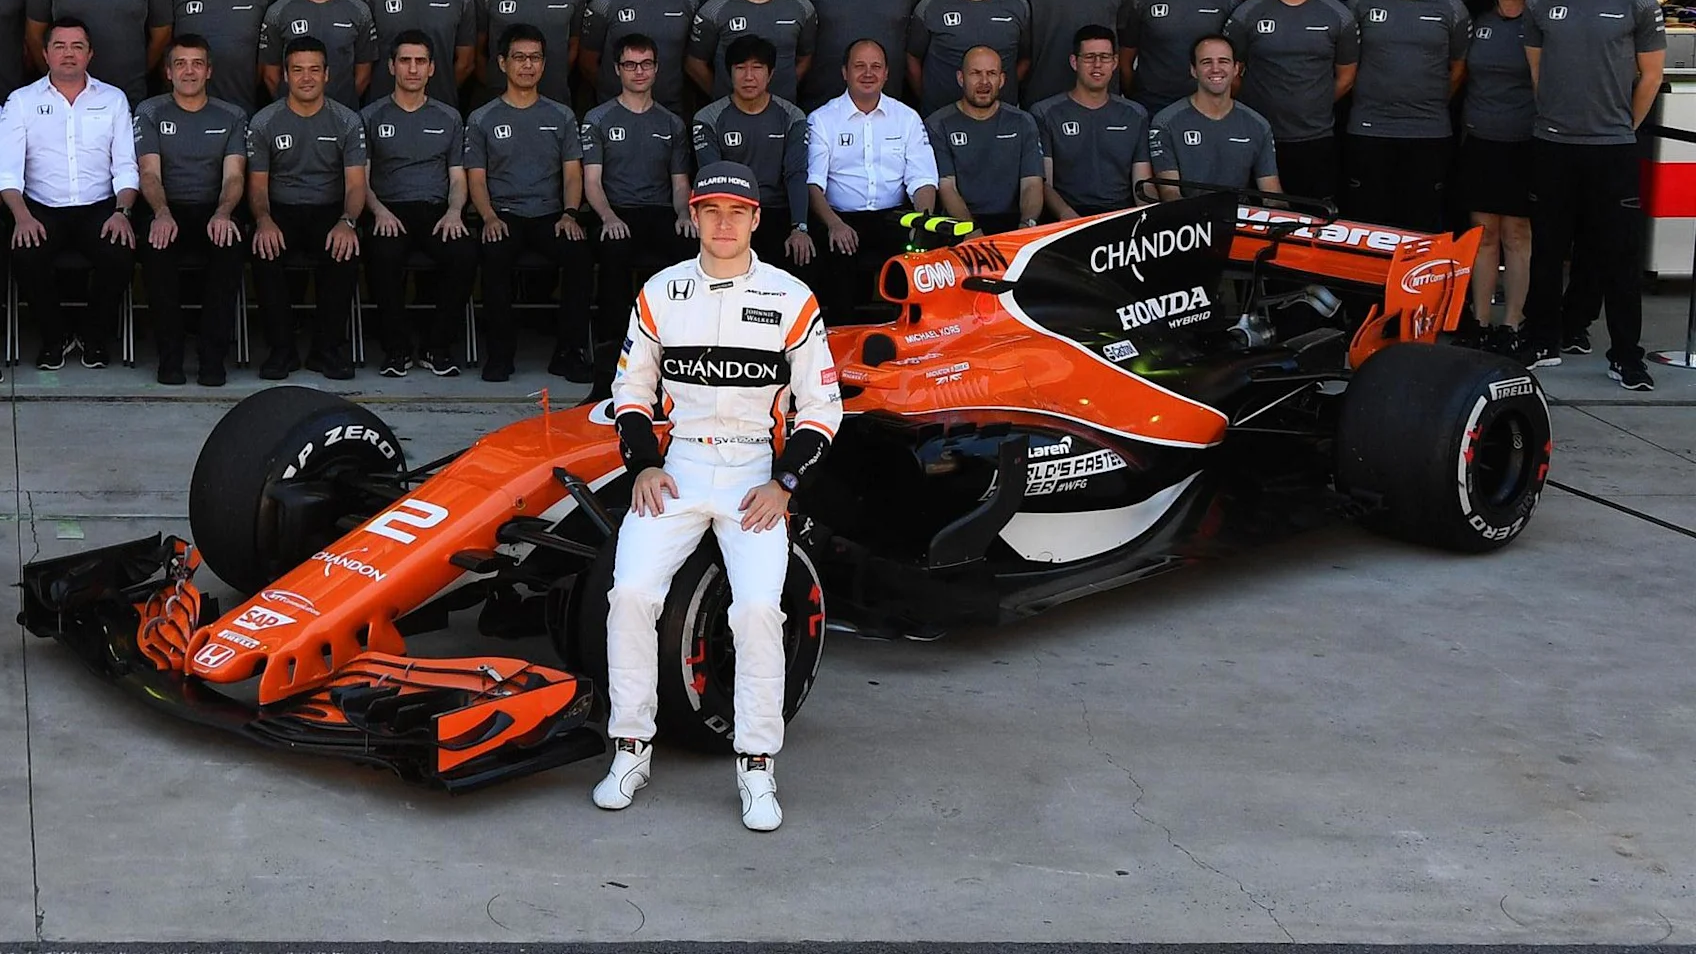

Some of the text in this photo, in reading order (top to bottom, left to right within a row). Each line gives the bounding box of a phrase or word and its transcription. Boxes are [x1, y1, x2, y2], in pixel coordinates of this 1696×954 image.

[1090, 221, 1212, 273] CHANDON
[913, 259, 956, 293] CNN
[744, 307, 775, 317] JOHNNIE
[747, 314, 775, 324] WALKER
[1116, 286, 1212, 331] HONDA
[1168, 310, 1212, 329] HYBRID
[905, 325, 961, 344] MICHAEL KORS
[664, 359, 777, 380] CHANDON
[1488, 375, 1534, 401] PIRELLI
[298, 425, 396, 469] P ZERO
[1028, 443, 1070, 459] Laren
[1056, 478, 1088, 493] #WFG
[365, 499, 449, 544] 2
[1468, 513, 1526, 542] ZERO
[312, 550, 388, 583] CHANDON
[239, 609, 280, 627] SAP
